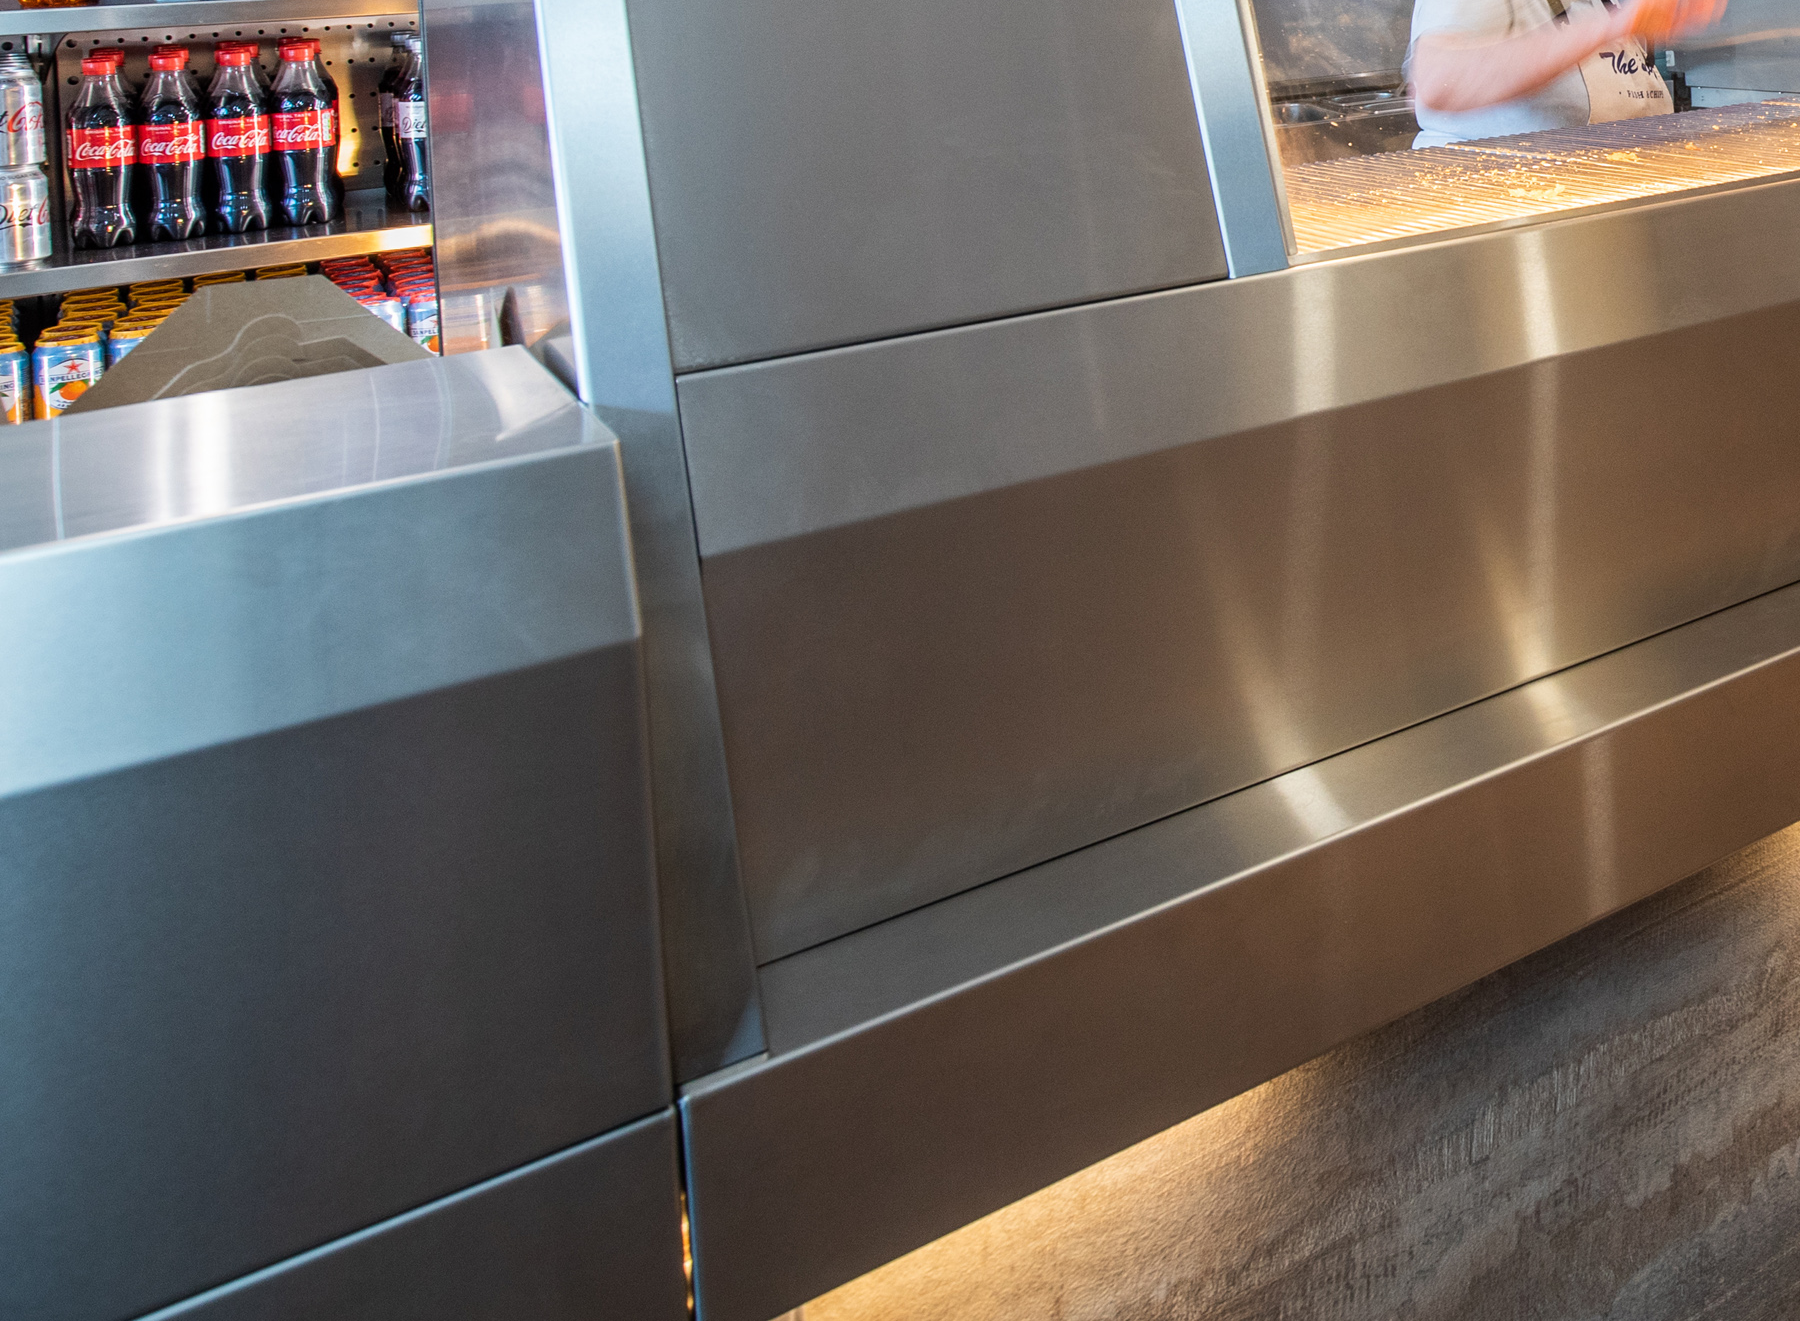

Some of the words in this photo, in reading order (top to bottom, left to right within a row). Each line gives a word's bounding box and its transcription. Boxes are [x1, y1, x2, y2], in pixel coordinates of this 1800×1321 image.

[1599, 50, 1639, 75] The
[141, 133, 199, 156] Coca-Cola
[212, 128, 269, 150] Coca-Cola
